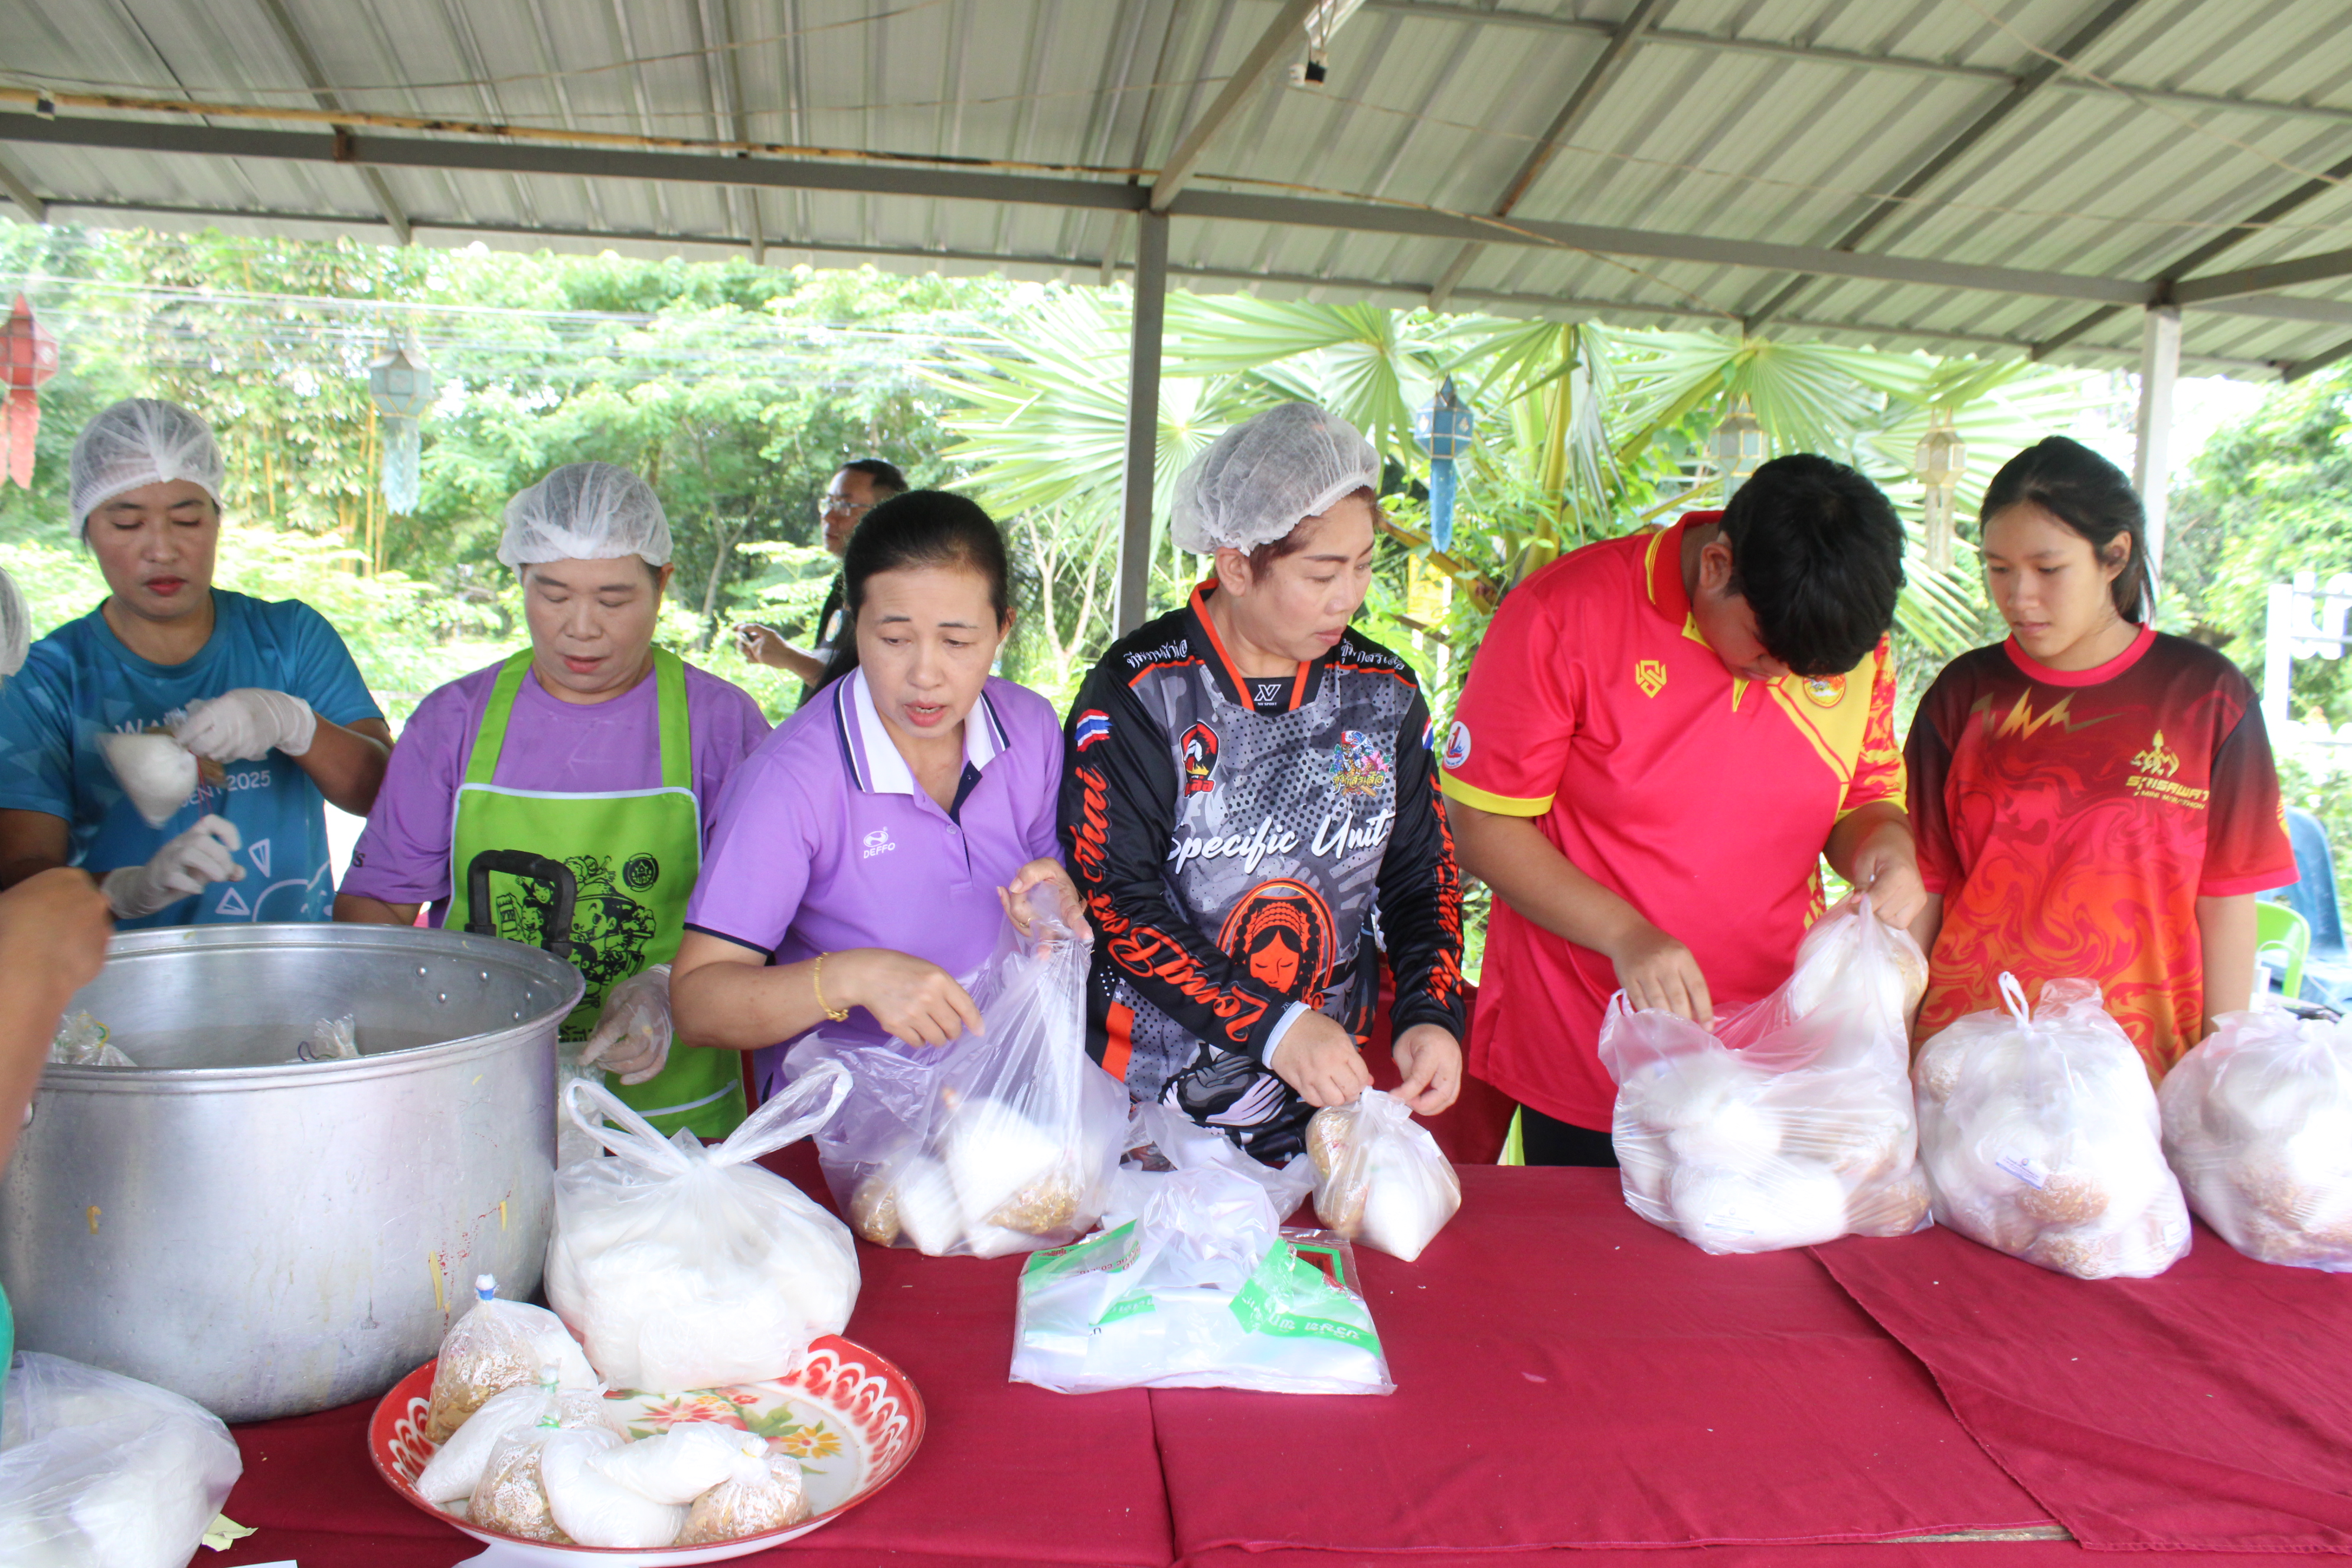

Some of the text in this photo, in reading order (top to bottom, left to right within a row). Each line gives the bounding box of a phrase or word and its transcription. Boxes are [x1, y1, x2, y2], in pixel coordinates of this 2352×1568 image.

[226, 770, 271, 792] 2025
[2140, 790, 2160, 798] MINI
[1311, 808, 1396, 859] Unit
[863, 842, 896, 858] DEFFO
